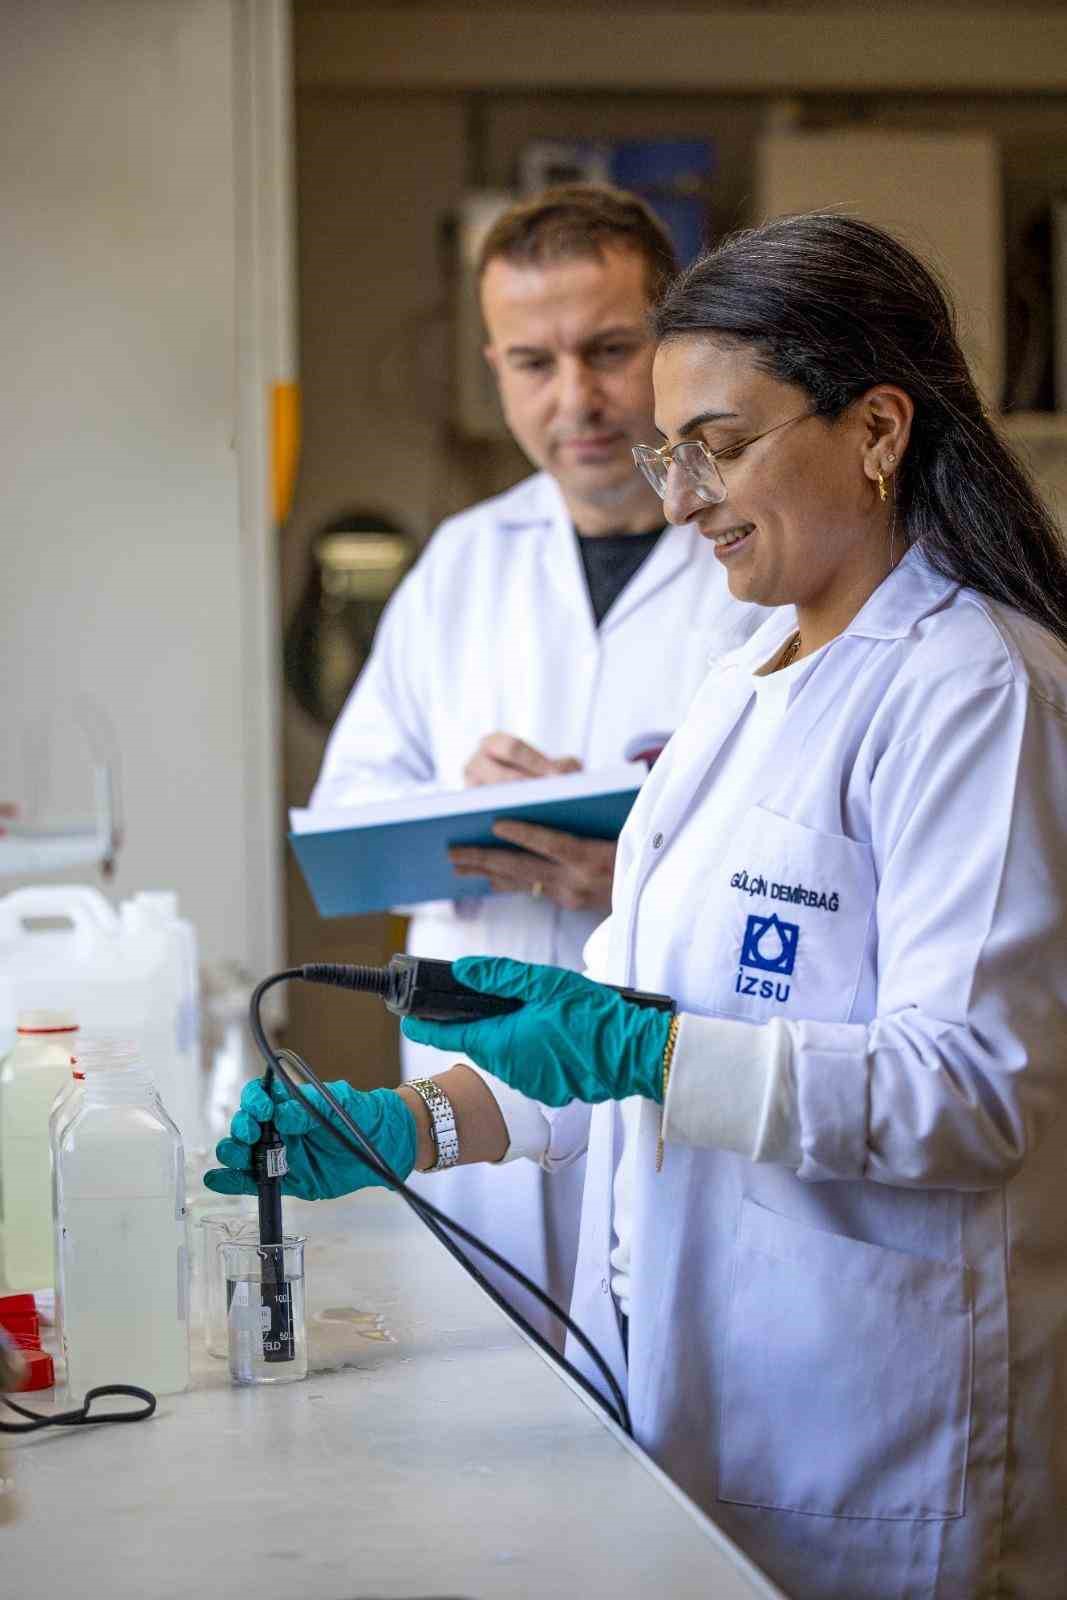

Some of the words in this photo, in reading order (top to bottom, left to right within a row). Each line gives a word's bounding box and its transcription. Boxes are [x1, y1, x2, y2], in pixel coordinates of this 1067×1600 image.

[731, 870, 768, 896] GÜLÇİN
[771, 883, 839, 912] DEMİRBAĞ
[736, 967, 790, 1002] İZSU
